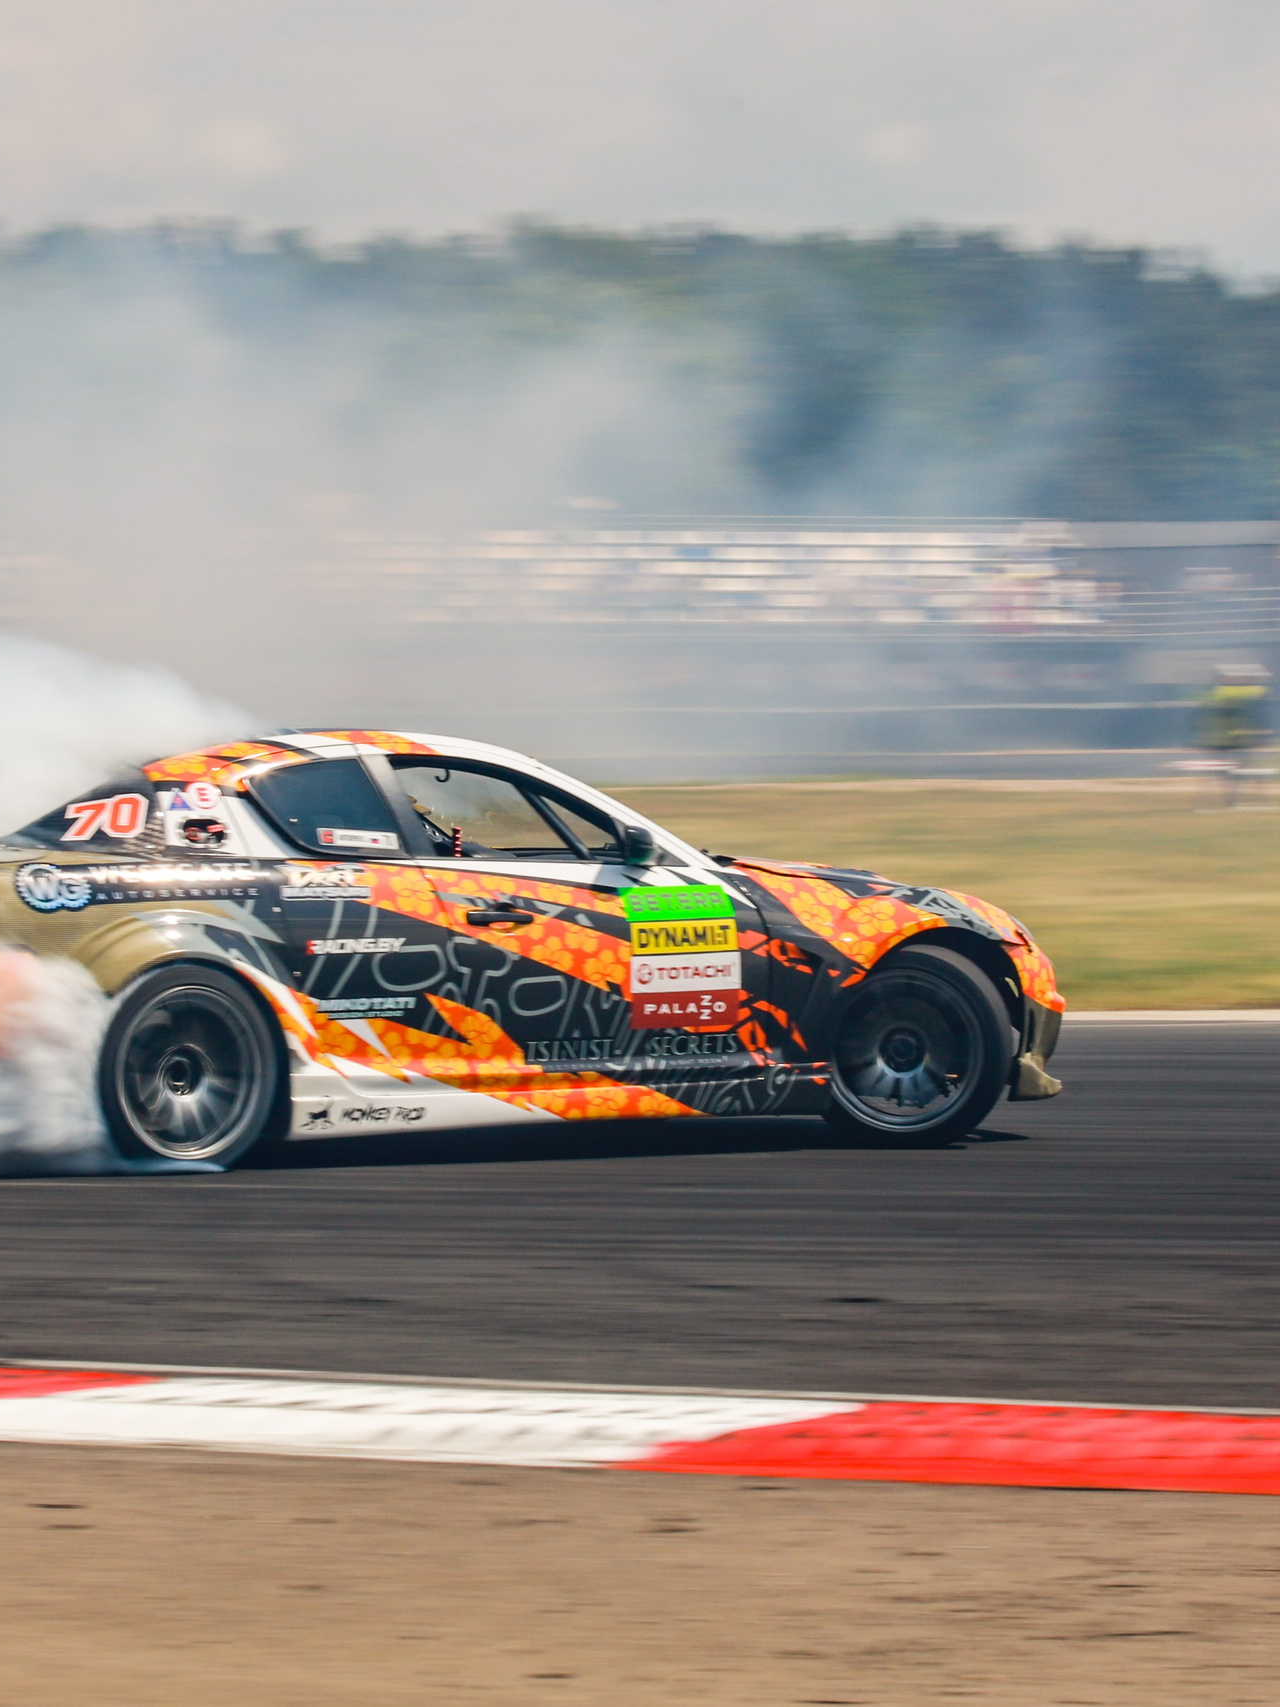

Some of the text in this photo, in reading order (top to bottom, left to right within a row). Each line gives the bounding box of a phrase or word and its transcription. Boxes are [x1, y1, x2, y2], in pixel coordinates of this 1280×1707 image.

[195, 786, 212, 803] E
[60, 793, 149, 841] 70
[656, 964, 731, 980] TOTACHI
[648, 1033, 739, 1057] SECRETS
